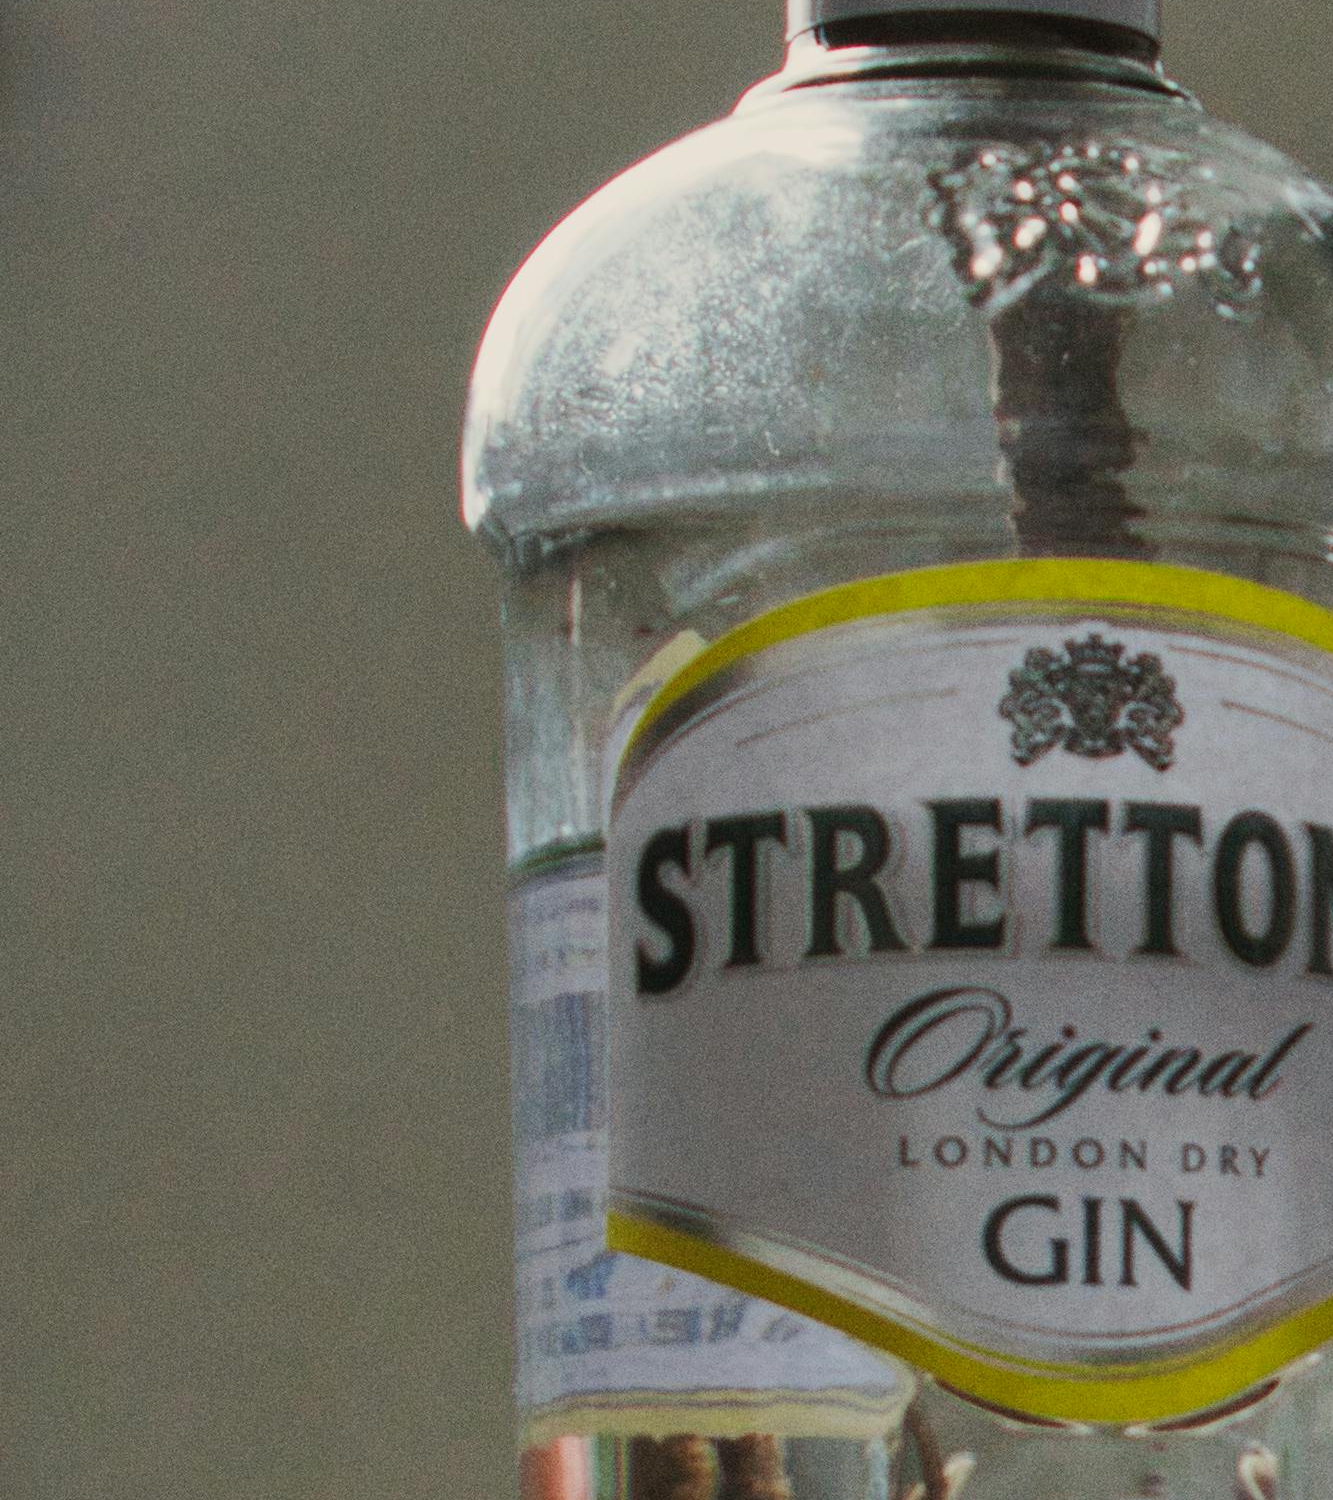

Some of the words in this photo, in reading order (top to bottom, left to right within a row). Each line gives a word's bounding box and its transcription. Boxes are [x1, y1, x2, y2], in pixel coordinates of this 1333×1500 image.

[862, 985, 1316, 1129] Original
[898, 1135, 1149, 1172] LONDON
[1181, 1142, 1272, 1179] DRY
[981, 1191, 1197, 1292] GIN
